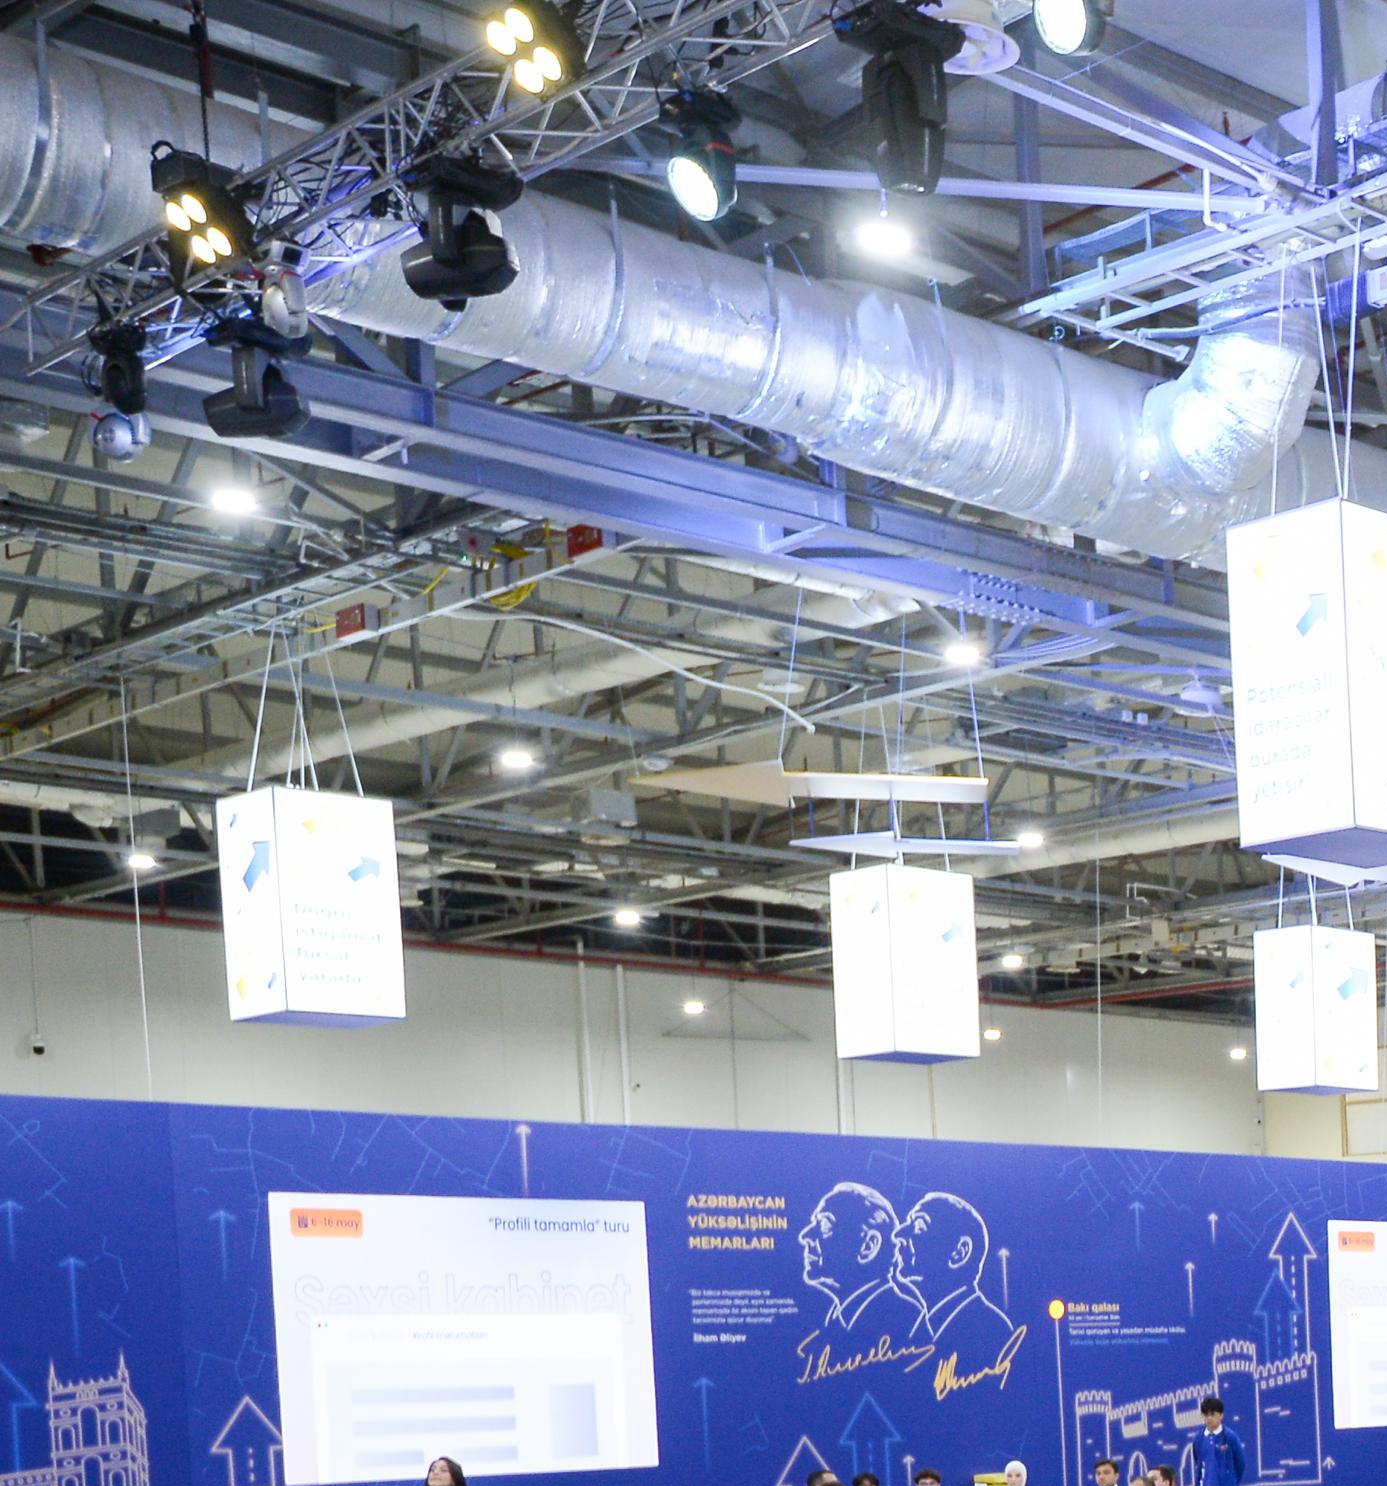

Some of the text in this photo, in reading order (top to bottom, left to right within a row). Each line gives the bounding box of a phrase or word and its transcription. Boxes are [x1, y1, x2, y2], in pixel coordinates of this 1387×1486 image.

[687, 1194, 786, 1210] AZƏRBAYCAN
[603, 1219, 630, 1233] turu
[688, 1213, 788, 1231] YÜKSƏLİŞİNİN
[689, 1236, 775, 1250] MEMARLARI
[1068, 1303, 1120, 1314] Bakı qalası
